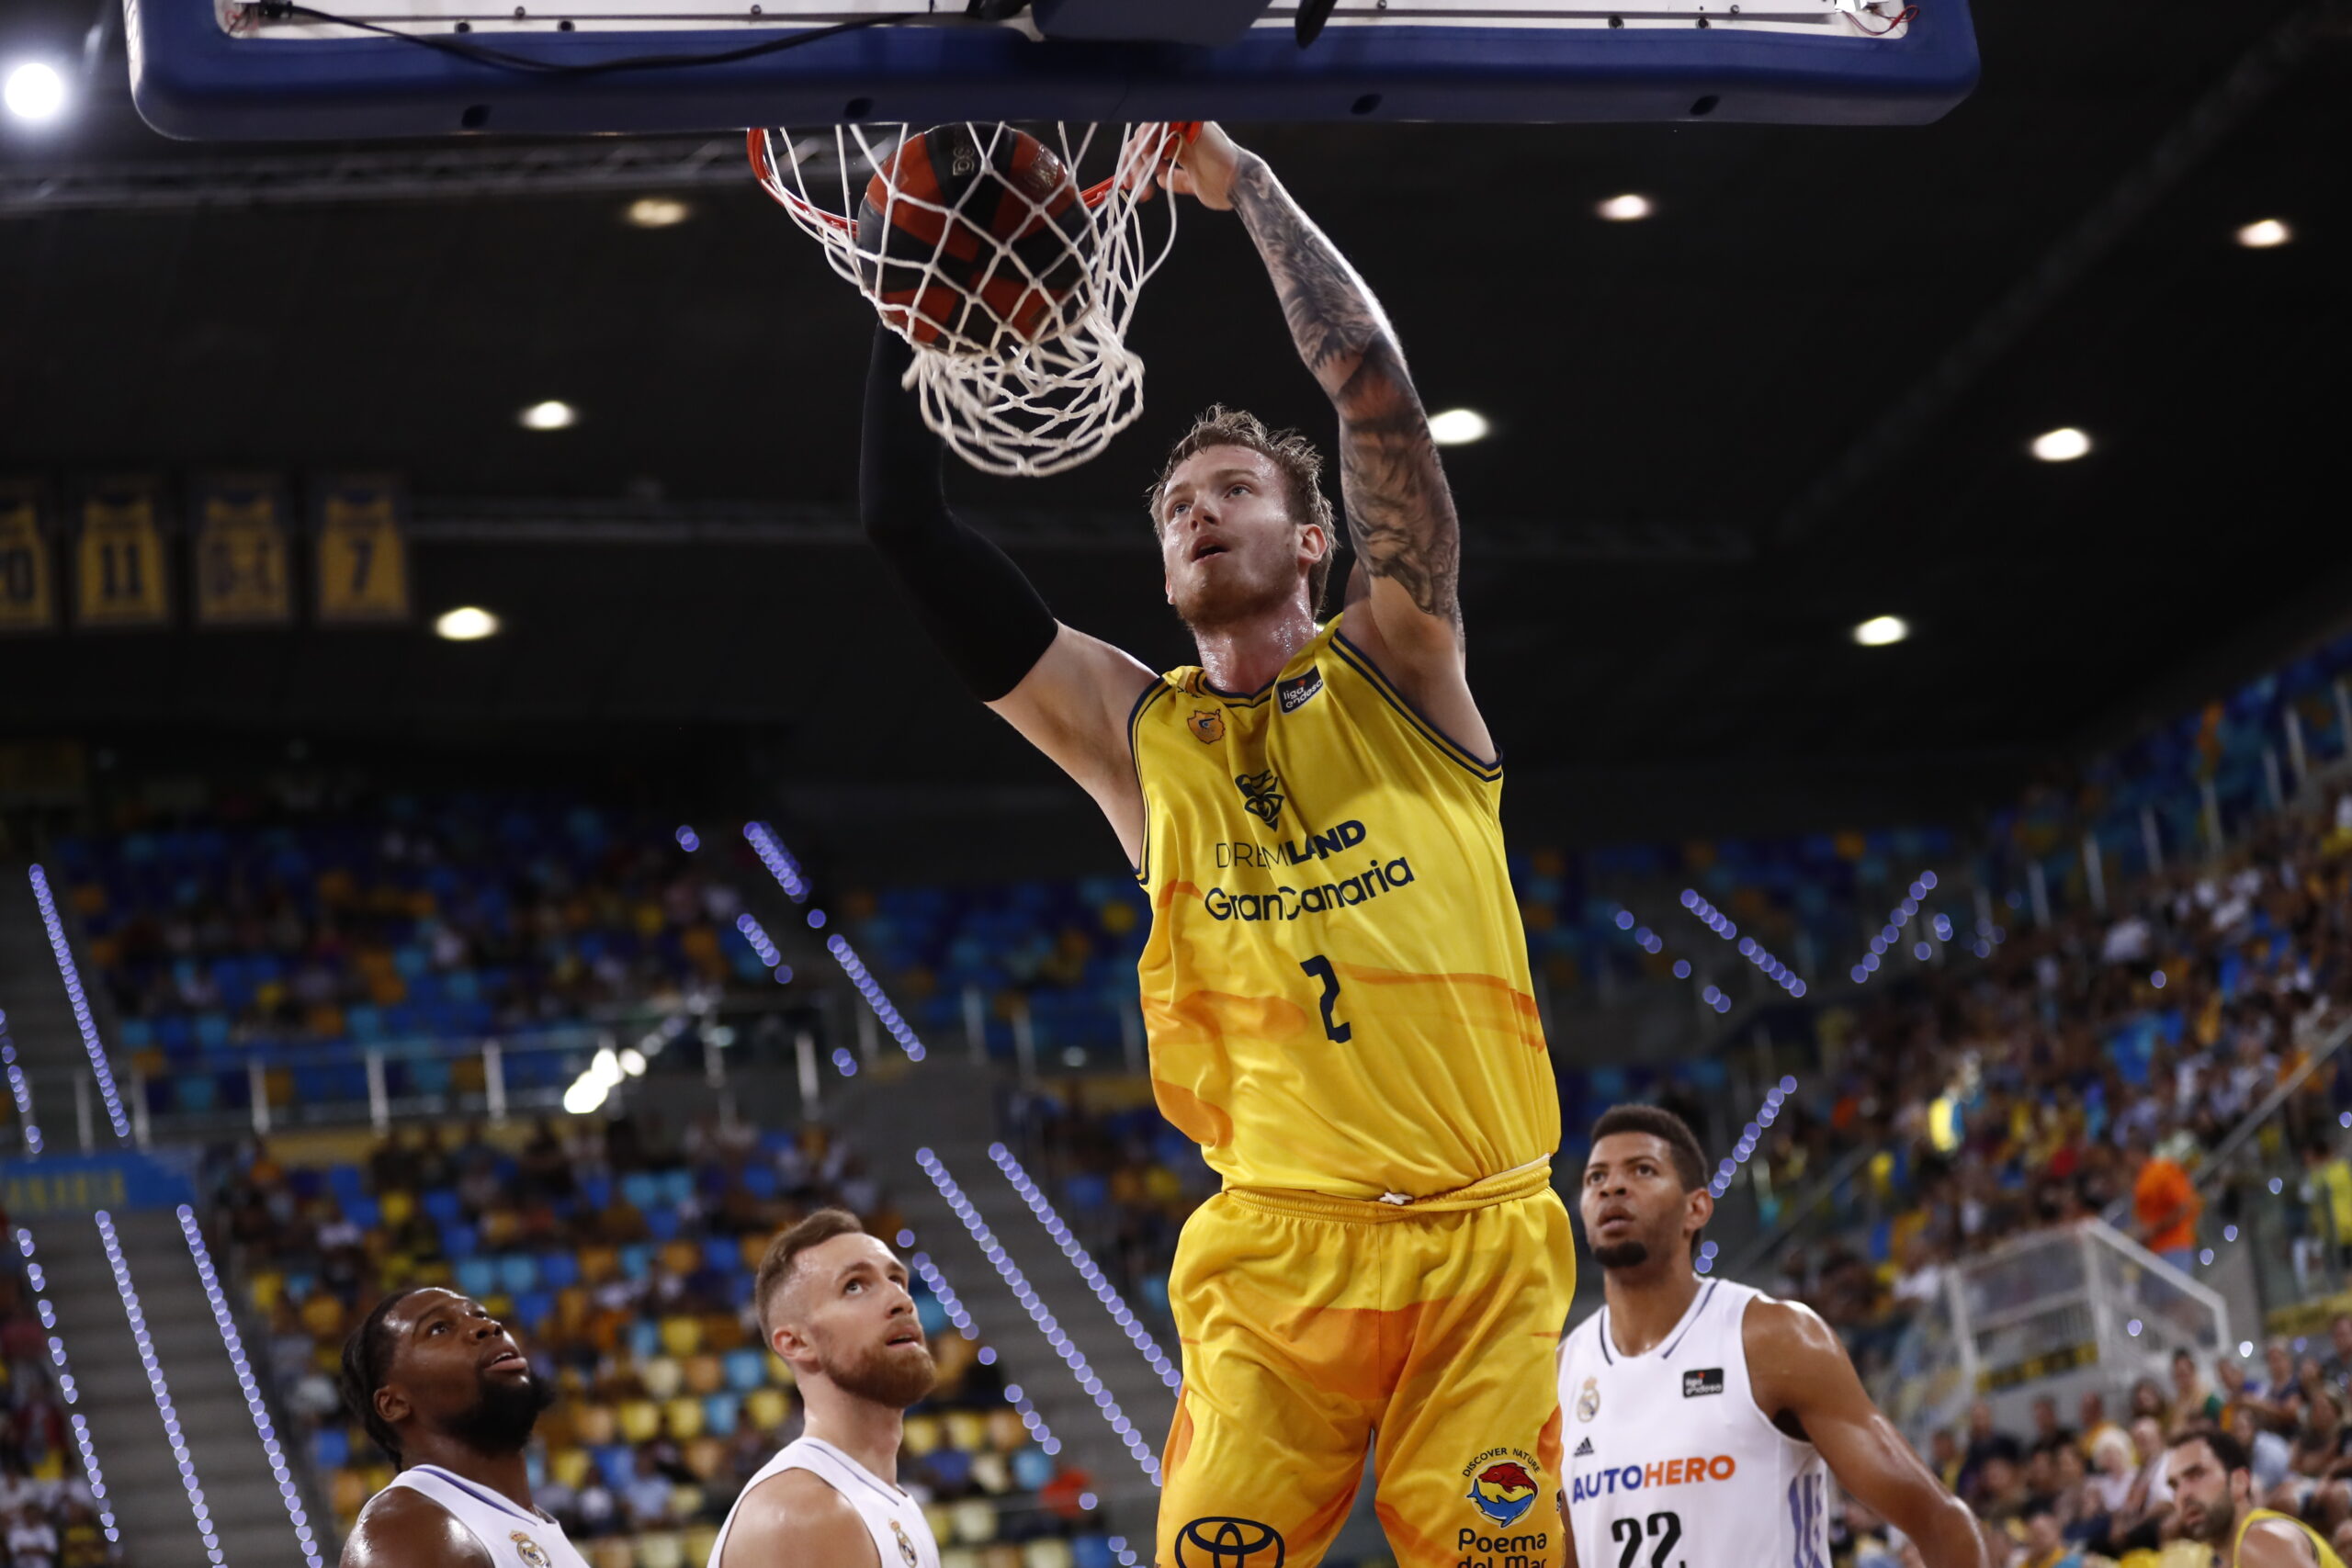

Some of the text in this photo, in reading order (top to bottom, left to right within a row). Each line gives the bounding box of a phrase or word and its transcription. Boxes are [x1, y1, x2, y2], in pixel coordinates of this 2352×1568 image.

[1283, 687, 1305, 700] liga
[1286, 680, 1322, 708] endesa
[1205, 857, 1415, 920] GranCanaria
[1300, 954, 1351, 1043] 2
[1463, 1448, 1541, 1477] DISCOVER NATURE
[1573, 1455, 1736, 1504] AUTOHERO
[1458, 1528, 1547, 1553] Poema
[1611, 1511, 1687, 1568] 22
